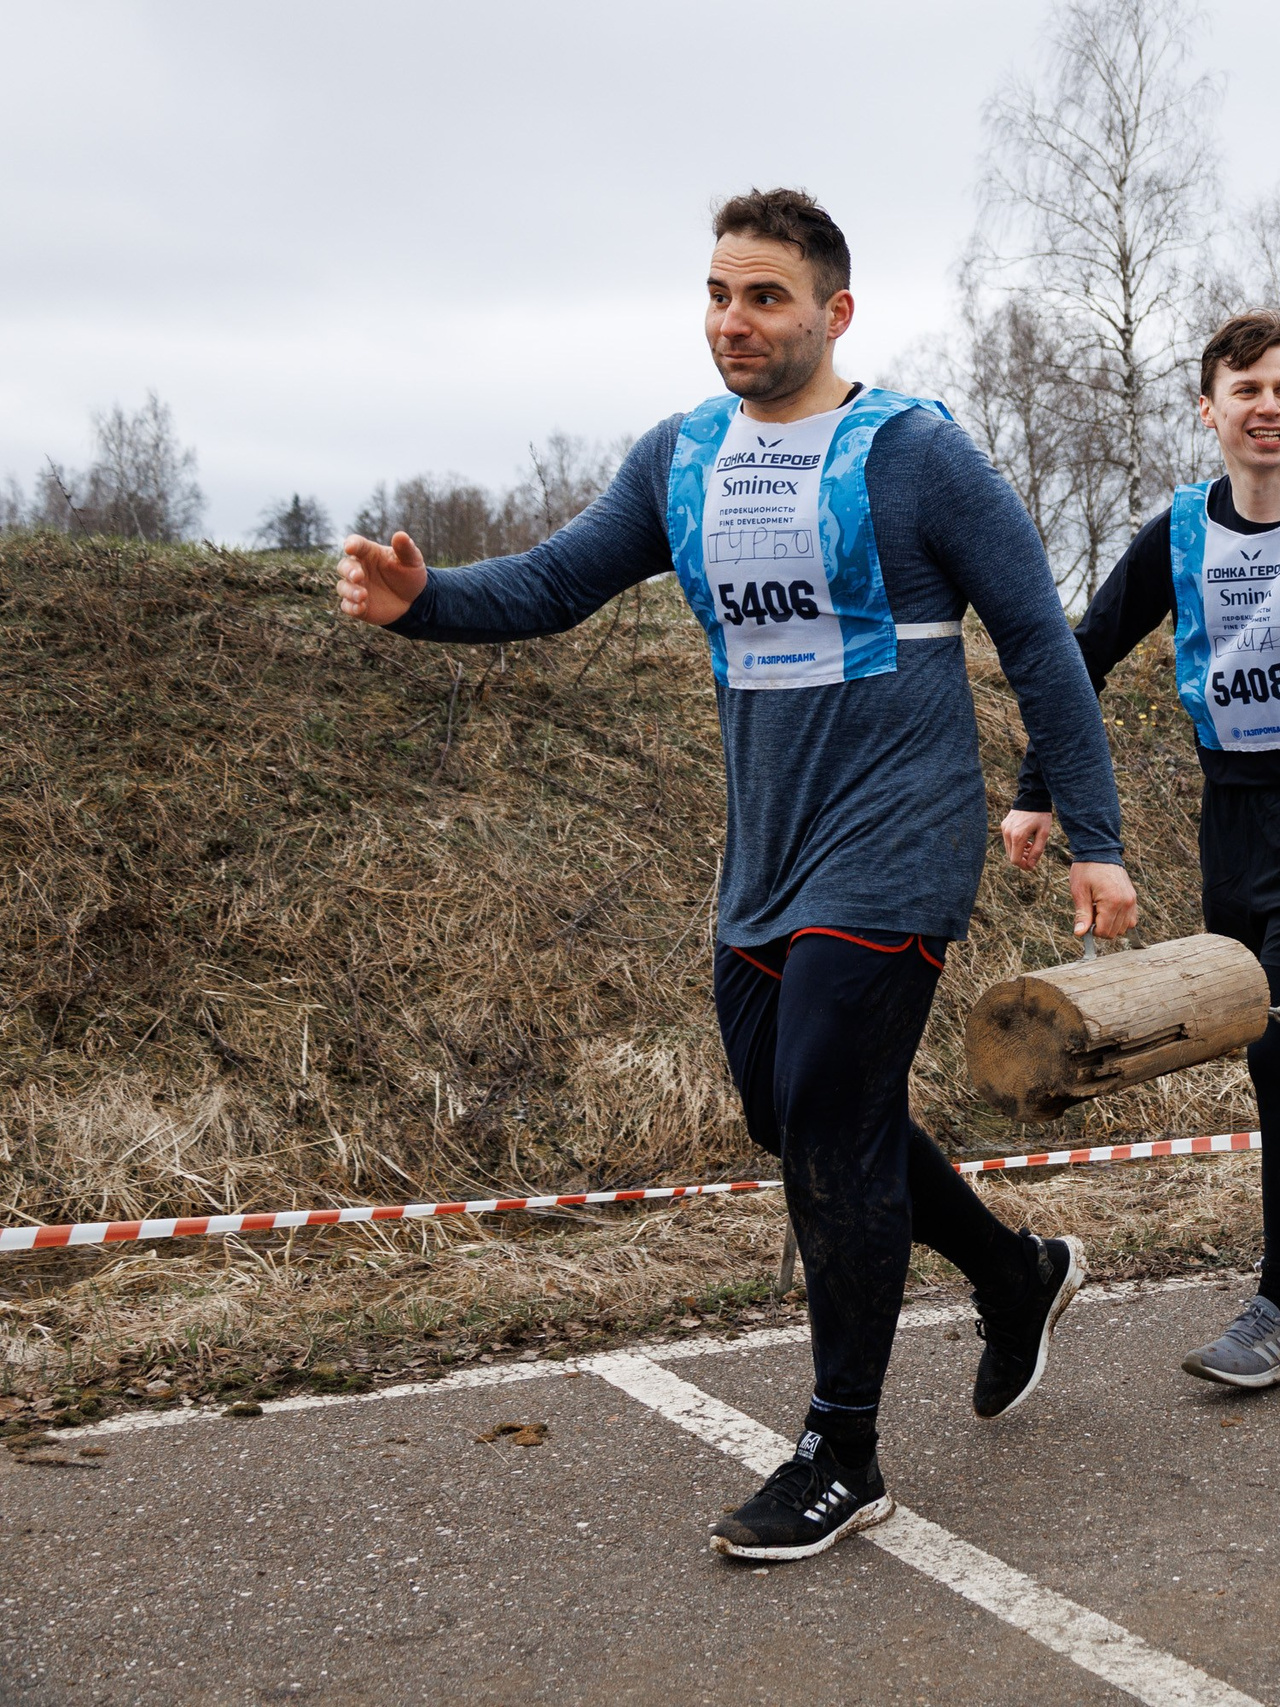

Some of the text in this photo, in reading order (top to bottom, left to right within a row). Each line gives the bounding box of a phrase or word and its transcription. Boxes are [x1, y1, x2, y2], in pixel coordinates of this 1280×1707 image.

[717, 453, 821, 468] ГОНКА ГЕРОЕВ
[721, 475, 799, 497] Sminex
[719, 506, 796, 516] ПЕРФЕКЦИОНИСТЫ
[737, 517, 794, 526] DEVELOPMENT
[1207, 566, 1246, 579] ГОНКА
[718, 580, 821, 626] 5406
[1220, 587, 1272, 607] Smin
[757, 652, 816, 665] ГАЗПРОМБАНК
